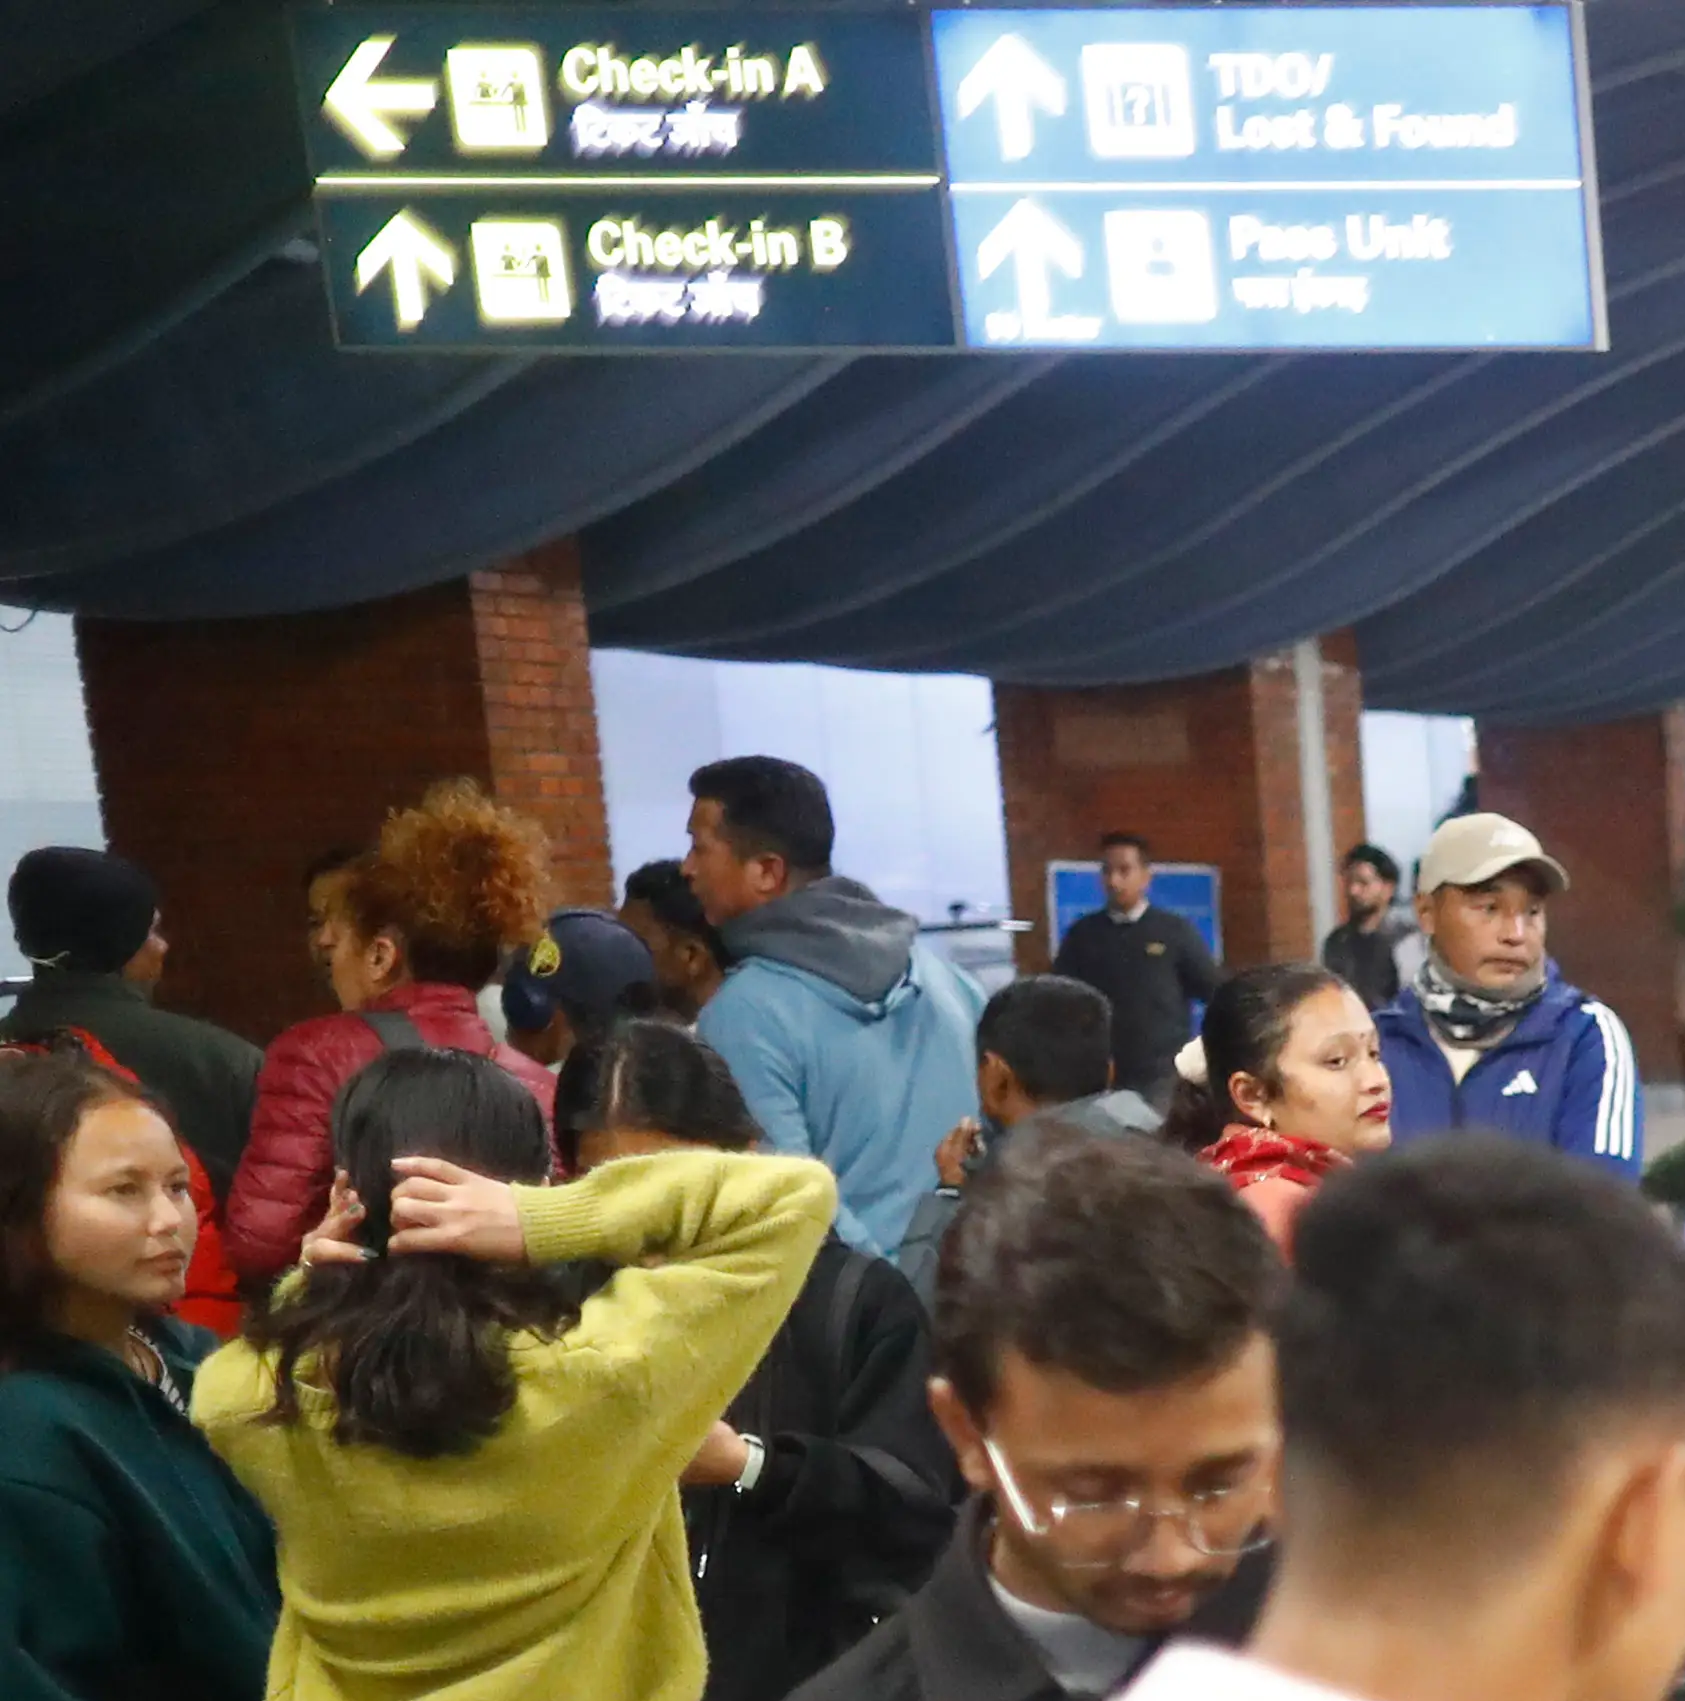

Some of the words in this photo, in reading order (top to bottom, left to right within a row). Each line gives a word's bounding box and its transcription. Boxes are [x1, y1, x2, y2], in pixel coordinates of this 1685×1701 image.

[560, 43, 778, 97] Check-in
[781, 43, 826, 97] A
[1215, 103, 1317, 150] Lost
[1322, 102, 1367, 150] &
[1372, 102, 1518, 149] Found
[586, 217, 800, 269] Check-in
[808, 217, 850, 269] B
